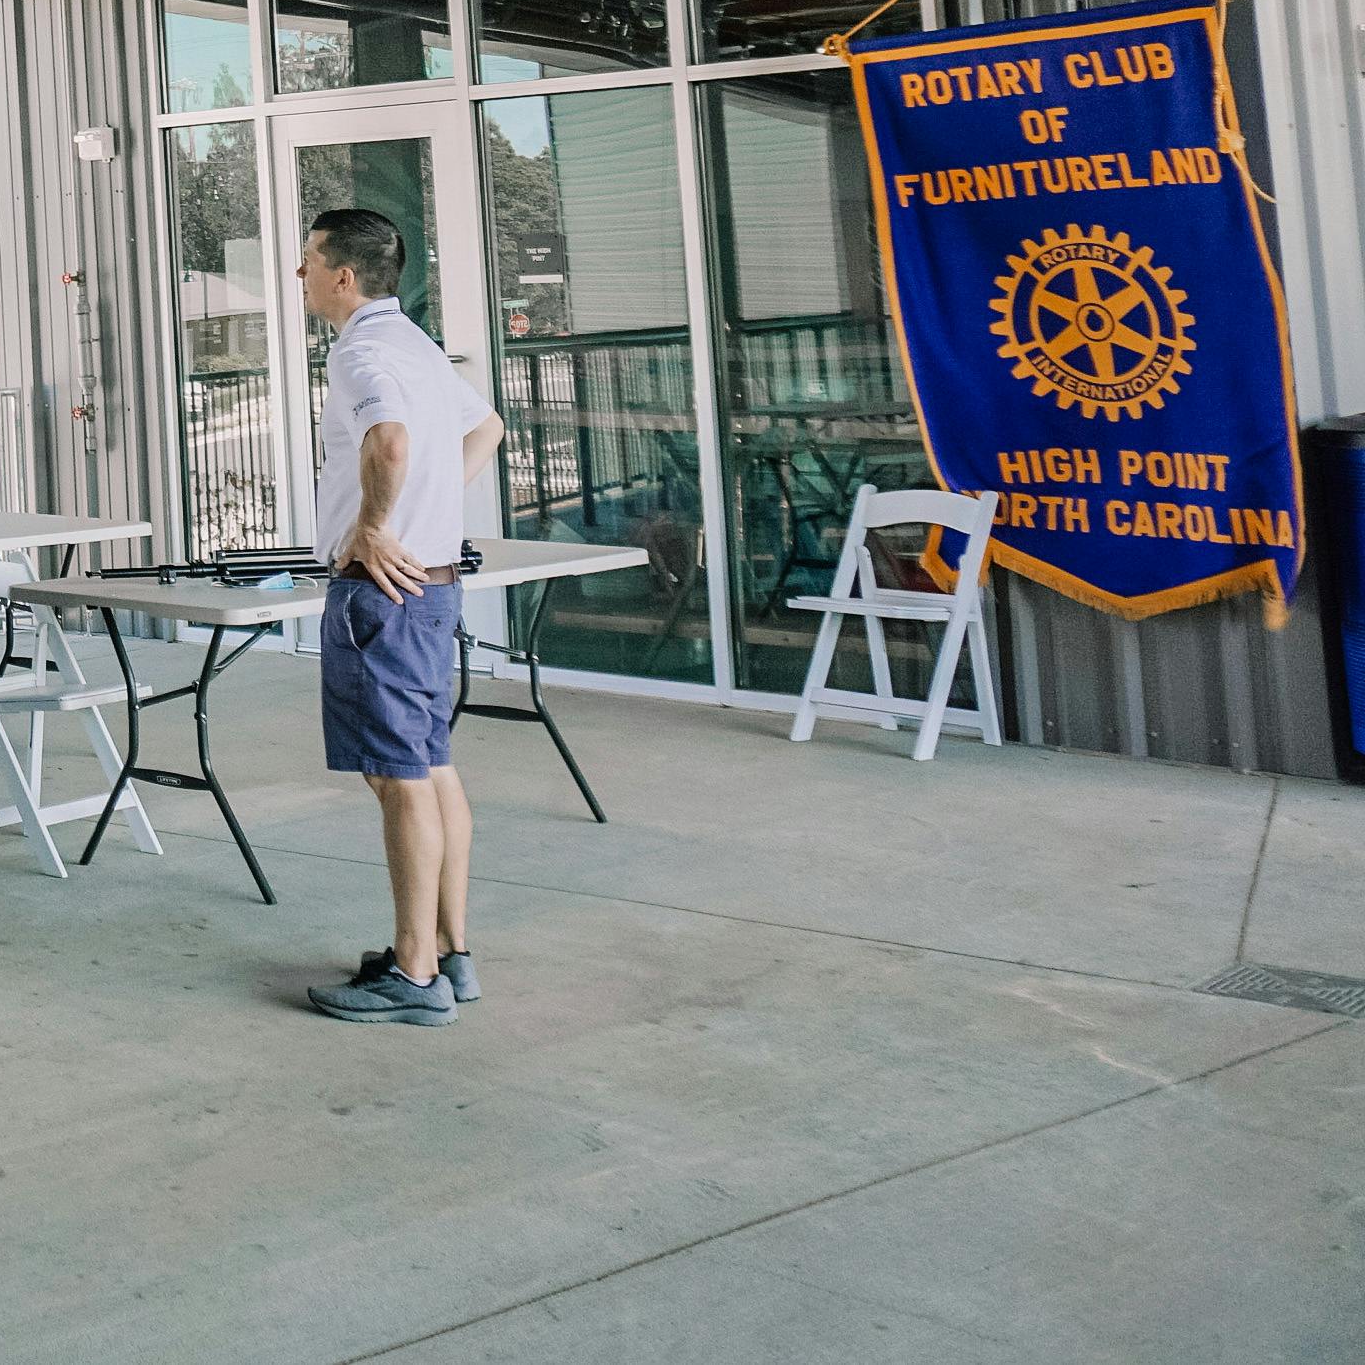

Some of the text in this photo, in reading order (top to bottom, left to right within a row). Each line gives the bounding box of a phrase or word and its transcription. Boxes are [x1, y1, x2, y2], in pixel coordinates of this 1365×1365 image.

[900, 42, 1175, 108] ROTARY CLUB
[1019, 106, 1069, 144] OF
[894, 147, 1222, 208] FURNITURELAND
[1040, 244, 1121, 268] ROTARY
[1032, 353, 1173, 401] INTERNATIONAL
[997, 447, 1229, 492] HIGH POINT
[981, 491, 1294, 549] ORTH CAROLINA
